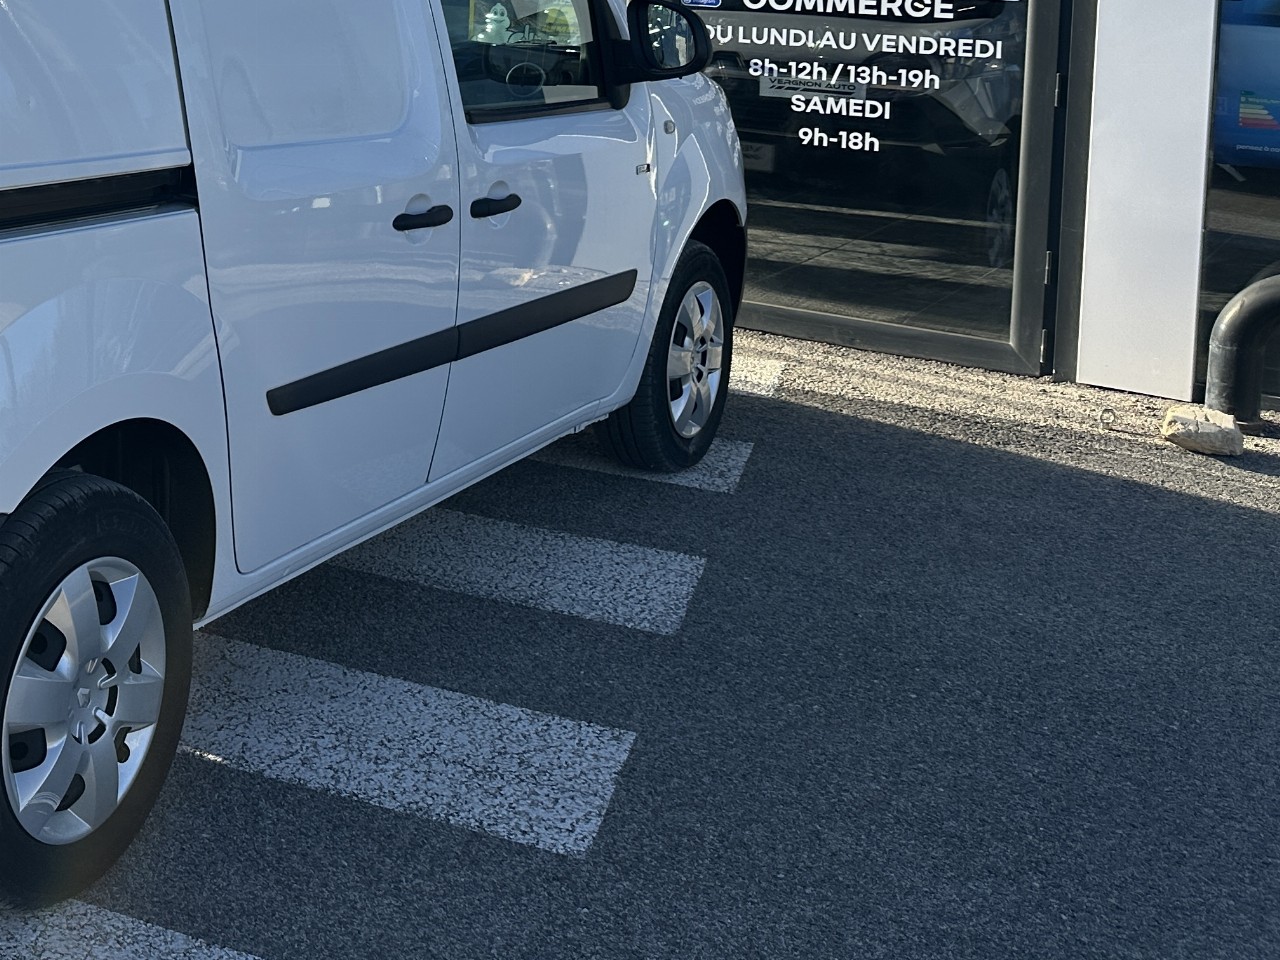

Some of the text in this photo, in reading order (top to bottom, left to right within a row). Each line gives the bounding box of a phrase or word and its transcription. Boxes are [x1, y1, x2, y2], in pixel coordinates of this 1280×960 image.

[738, 26, 815, 48] LUNDI
[819, 31, 856, 51] AU
[862, 33, 1002, 59] VENDREDI
[769, 78, 856, 91] VERGNON AUTO
[790, 94, 891, 120] SAMEDI
[798, 127, 880, 152] 9h-18h
